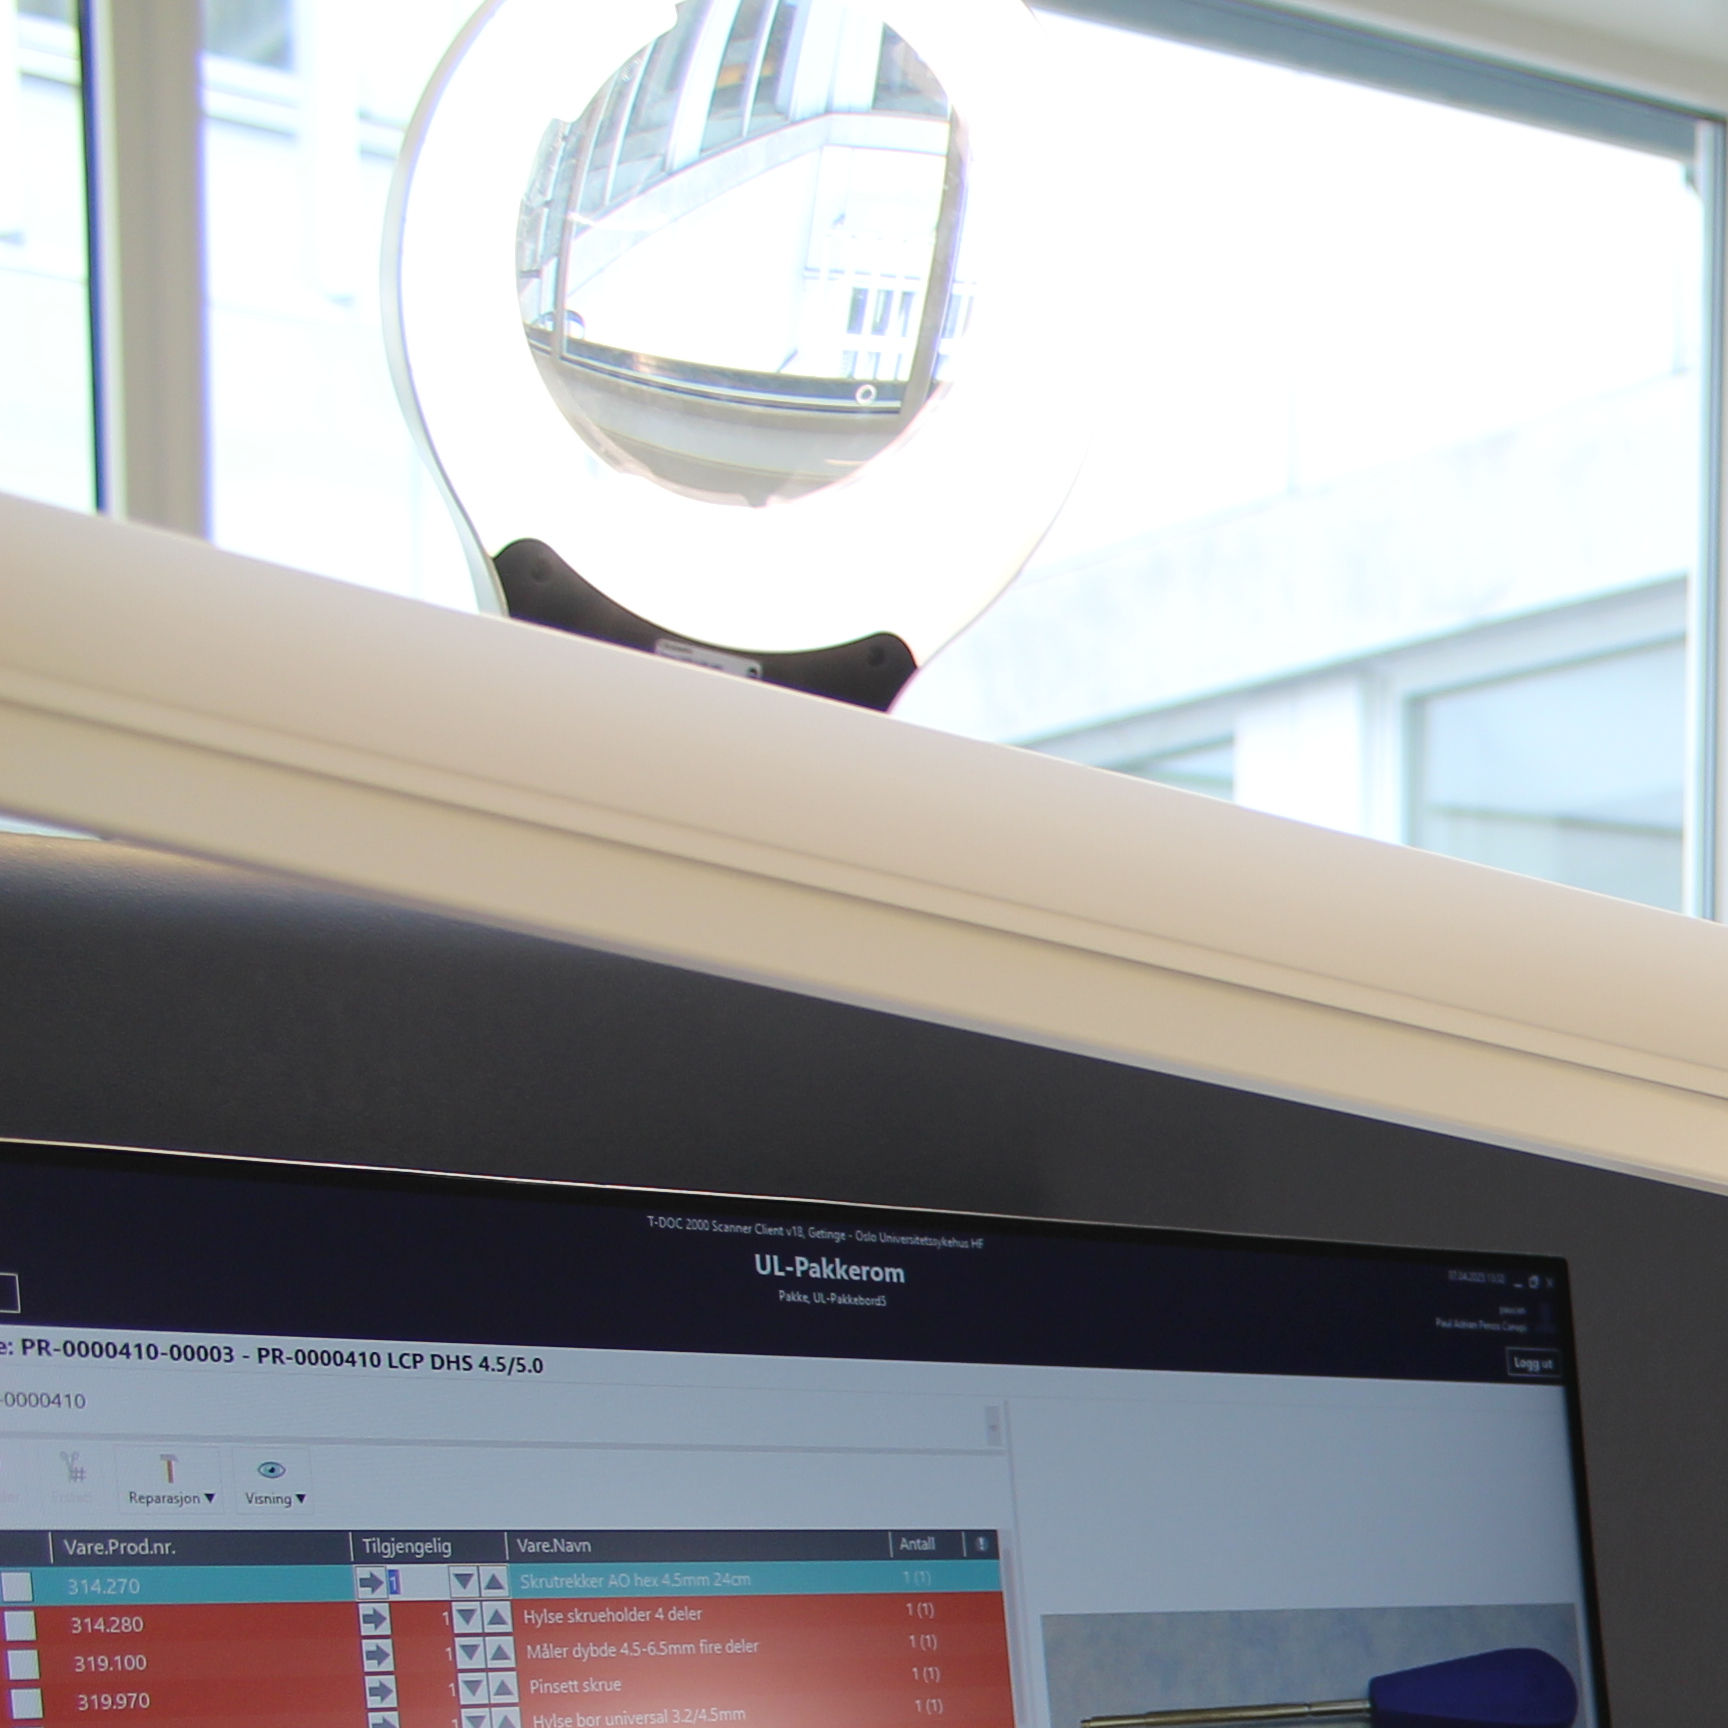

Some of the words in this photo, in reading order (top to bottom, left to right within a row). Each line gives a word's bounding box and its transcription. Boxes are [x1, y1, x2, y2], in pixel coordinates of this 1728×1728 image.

[646, 1215, 683, 1229] T-DOC
[685, 1218, 709, 1231] 2000
[711, 1220, 752, 1234] Scanner
[754, 1223, 784, 1236] Client
[754, 1254, 905, 1282] UL-Pakkerom
[21, 1338, 234, 1362] PR-0000410-00003
[257, 1347, 381, 1367] PR-0000410
[387, 1352, 424, 1369] LCP
[430, 1353, 472, 1371] DHS
[478, 1356, 543, 1375] 4.5/5.0
[1514, 1357, 1539, 1371] Logg
[1541, 1360, 1553, 1369] ut
[129, 1492, 200, 1507] Reparasjon
[246, 1492, 292, 1508] Visning
[64, 1538, 176, 1556] Vare.Prod.nr.
[362, 1537, 452, 1558] Tilgjengelig
[516, 1538, 591, 1553] Vare.Navn
[900, 1536, 936, 1551] Antall
[68, 1578, 140, 1595] 314.270
[520, 1573, 604, 1588] Skrutrekker
[608, 1573, 630, 1588] AO
[633, 1573, 658, 1587] hex
[661, 1572, 710, 1587] 4.5mm
[713, 1572, 751, 1586] 24cm
[71, 1617, 143, 1634] 314.280
[523, 1608, 563, 1628] Hylse
[567, 1607, 651, 1623] skrueholder
[654, 1607, 664, 1620] 4
[667, 1606, 702, 1621] deler
[526, 1643, 569, 1658] Måler
[572, 1642, 616, 1661] dybde
[619, 1641, 695, 1656] 4.5-6.5mm
[699, 1639, 722, 1654] fire
[725, 1638, 759, 1653] deler
[74, 1655, 147, 1672] 319.100
[530, 1678, 579, 1693] Pinsett
[582, 1677, 621, 1692] skrue
[78, 1693, 150, 1711] 319.970
[575, 1712, 601, 1727] bor
[605, 1709, 668, 1726] universal
[672, 1707, 745, 1723] 3.2/4.5mm
